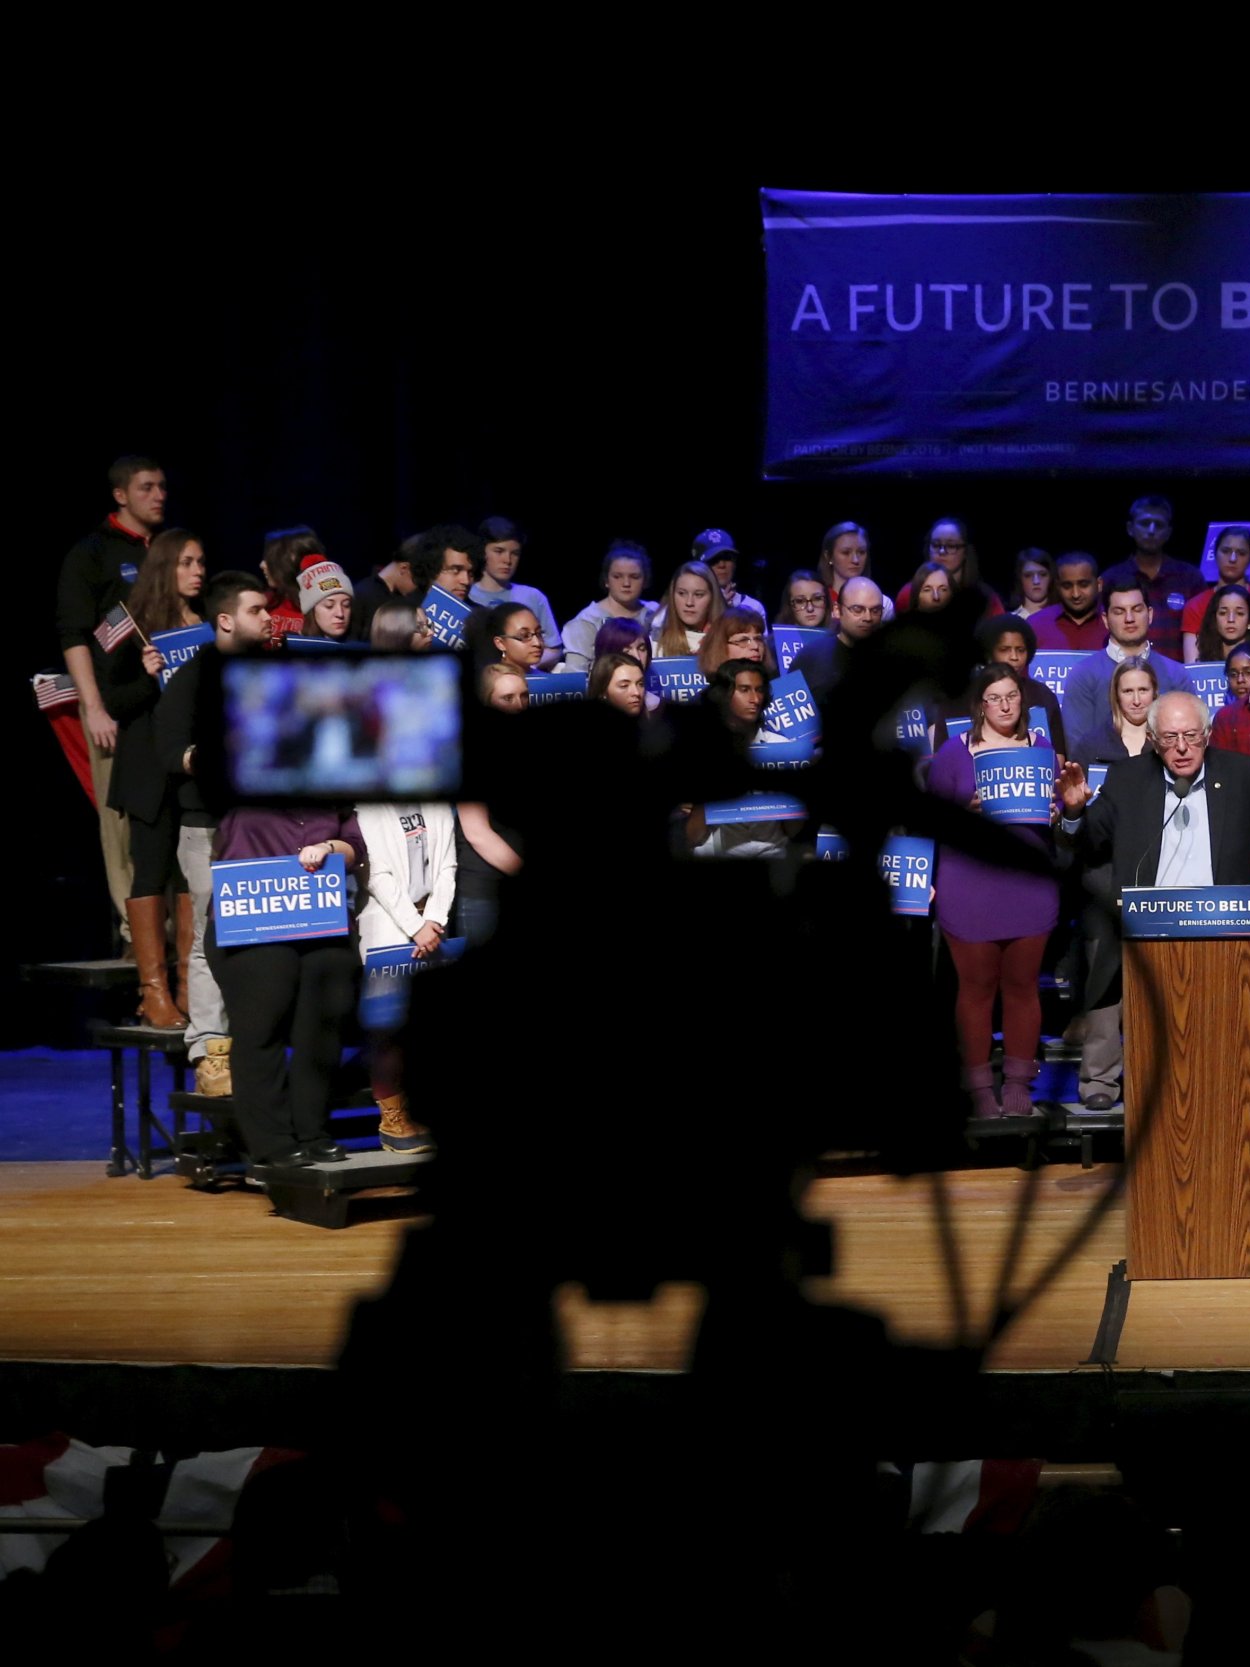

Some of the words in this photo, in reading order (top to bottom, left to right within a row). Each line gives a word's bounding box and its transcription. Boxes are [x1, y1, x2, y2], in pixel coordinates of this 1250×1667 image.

[791, 283, 831, 332] A
[848, 283, 1093, 332] FUTURE
[1109, 282, 1199, 332] TO
[426, 603, 436, 617] A
[781, 641, 790, 653] A
[1034, 667, 1044, 678] A
[785, 690, 808, 706] TO
[798, 703, 816, 722] IN
[904, 709, 922, 720] TO
[908, 723, 926, 738] IN
[981, 766, 1034, 783] FUTURE
[1038, 766, 1053, 781] TO
[905, 856, 929, 871] TO
[220, 882, 233, 897] A
[237, 876, 310, 896] FUTURE
[314, 873, 340, 888] TO
[905, 872, 928, 889] IN
[220, 893, 312, 917] BELIEVE
[317, 890, 342, 909] IN
[1128, 901, 1138, 913] A
[1140, 901, 1193, 913] FUTURE
[1193, 900, 1216, 912] TO
